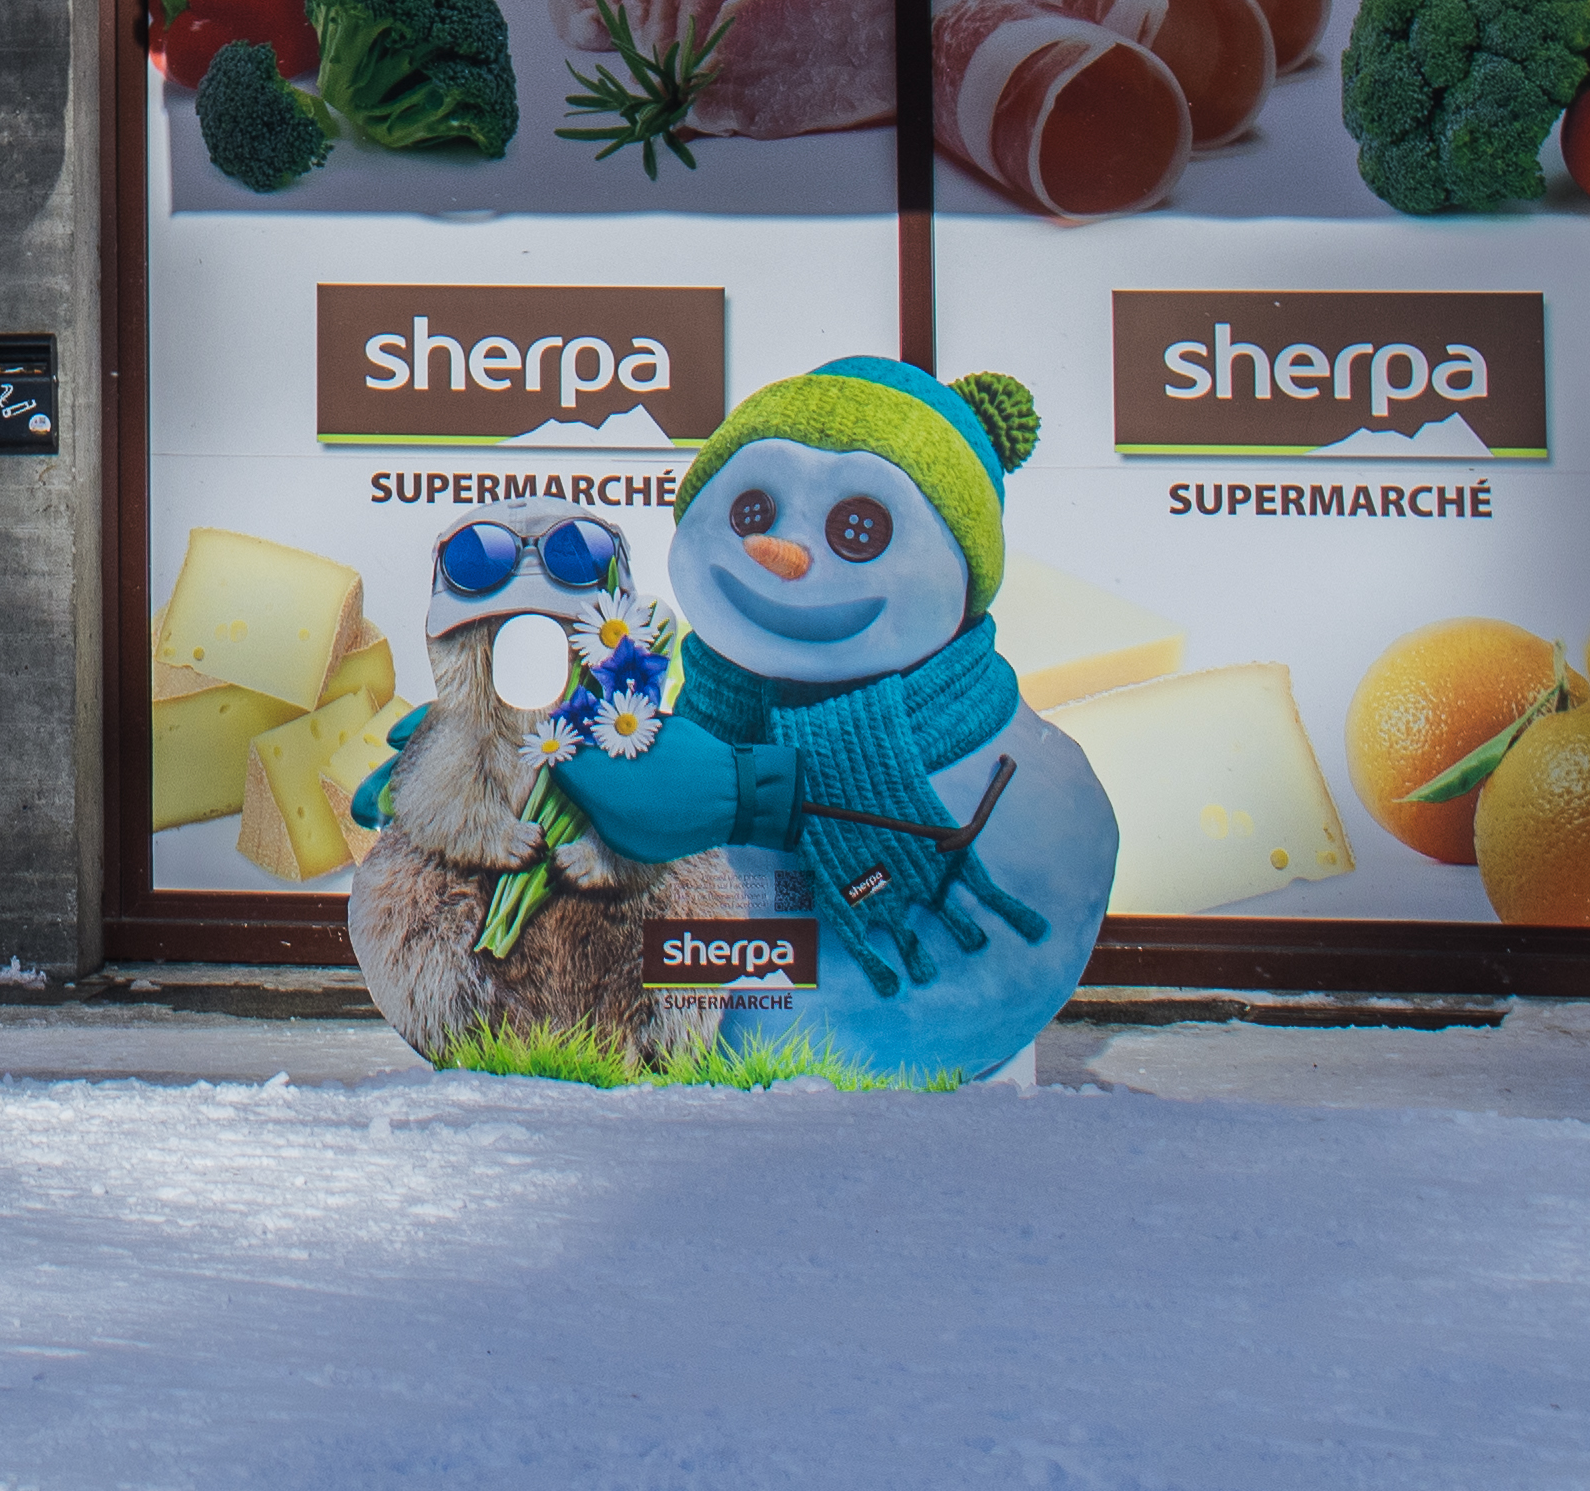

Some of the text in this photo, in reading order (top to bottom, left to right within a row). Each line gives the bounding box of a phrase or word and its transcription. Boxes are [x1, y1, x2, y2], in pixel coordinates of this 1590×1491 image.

[364, 315, 671, 408] sherpa
[1163, 323, 1488, 418] sherpa
[370, 468, 677, 507] SUPERMARCHÉ
[1168, 478, 1493, 518] SUPERMARCHÉ
[849, 871, 883, 898] sherpa
[663, 931, 794, 972] sherpa
[664, 992, 793, 1010] SUPERMARCHÉ
